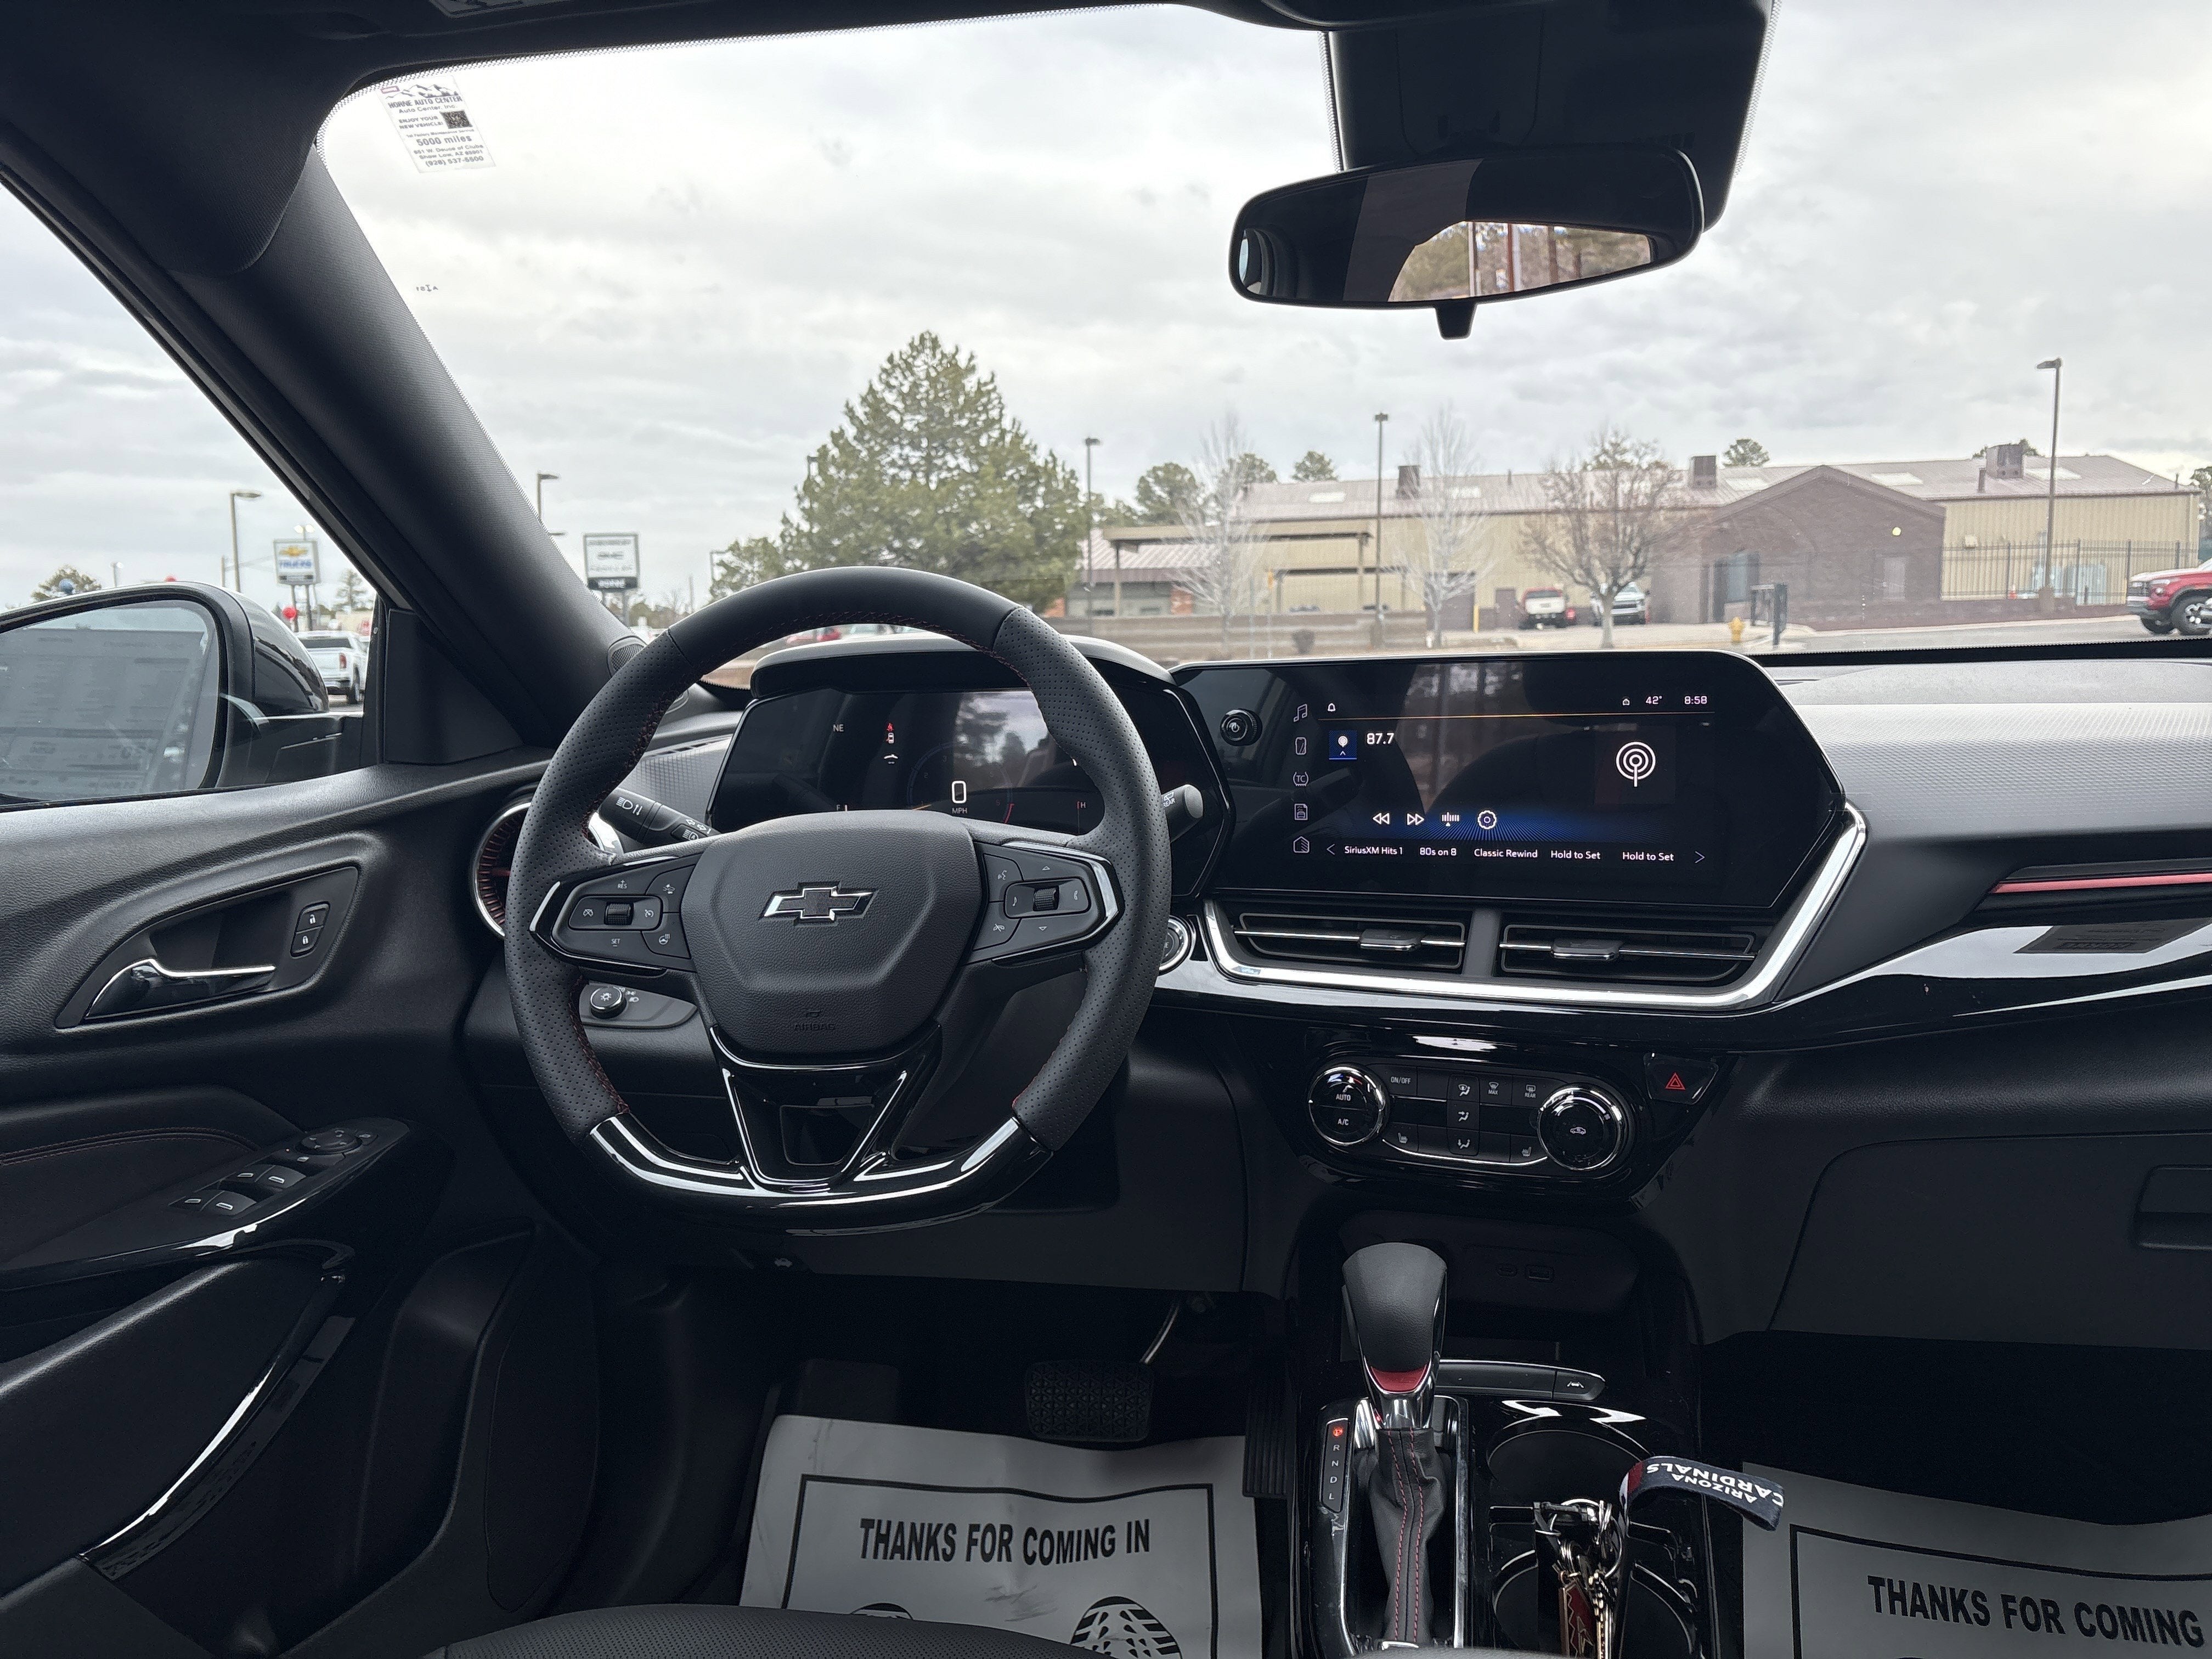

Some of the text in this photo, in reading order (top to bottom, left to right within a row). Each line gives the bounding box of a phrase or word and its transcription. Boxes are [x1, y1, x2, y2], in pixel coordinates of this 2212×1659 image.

[388, 100, 413, 109] HORNE
[435, 95, 463, 104] CENTER
[416, 135, 472, 146] 5000 miles
[1684, 696, 1707, 704] 8:58
[833, 724, 844, 732] NE
[1367, 732, 1395, 744] 87.7
[951, 780, 967, 804] 0
[1344, 845, 1380, 855] SiriusXM
[1381, 847, 1398, 855] Hits
[1419, 848, 1436, 856] 80s
[1451, 848, 1457, 856] 8
[1474, 848, 1538, 859] Classic Rewind
[1551, 850, 1601, 860] Hold to Set
[1622, 851, 1674, 861] Hold to Set
[1390, 1076, 1412, 1085] ON/OFF
[1646, 1463, 1784, 1508] CARDINALS
[1671, 1473, 1758, 1504] ARIZONA
[859, 1518, 1151, 1566] THANKS FOR COMING IN
[1867, 1575, 2205, 1648] THANKS FOR COMING
